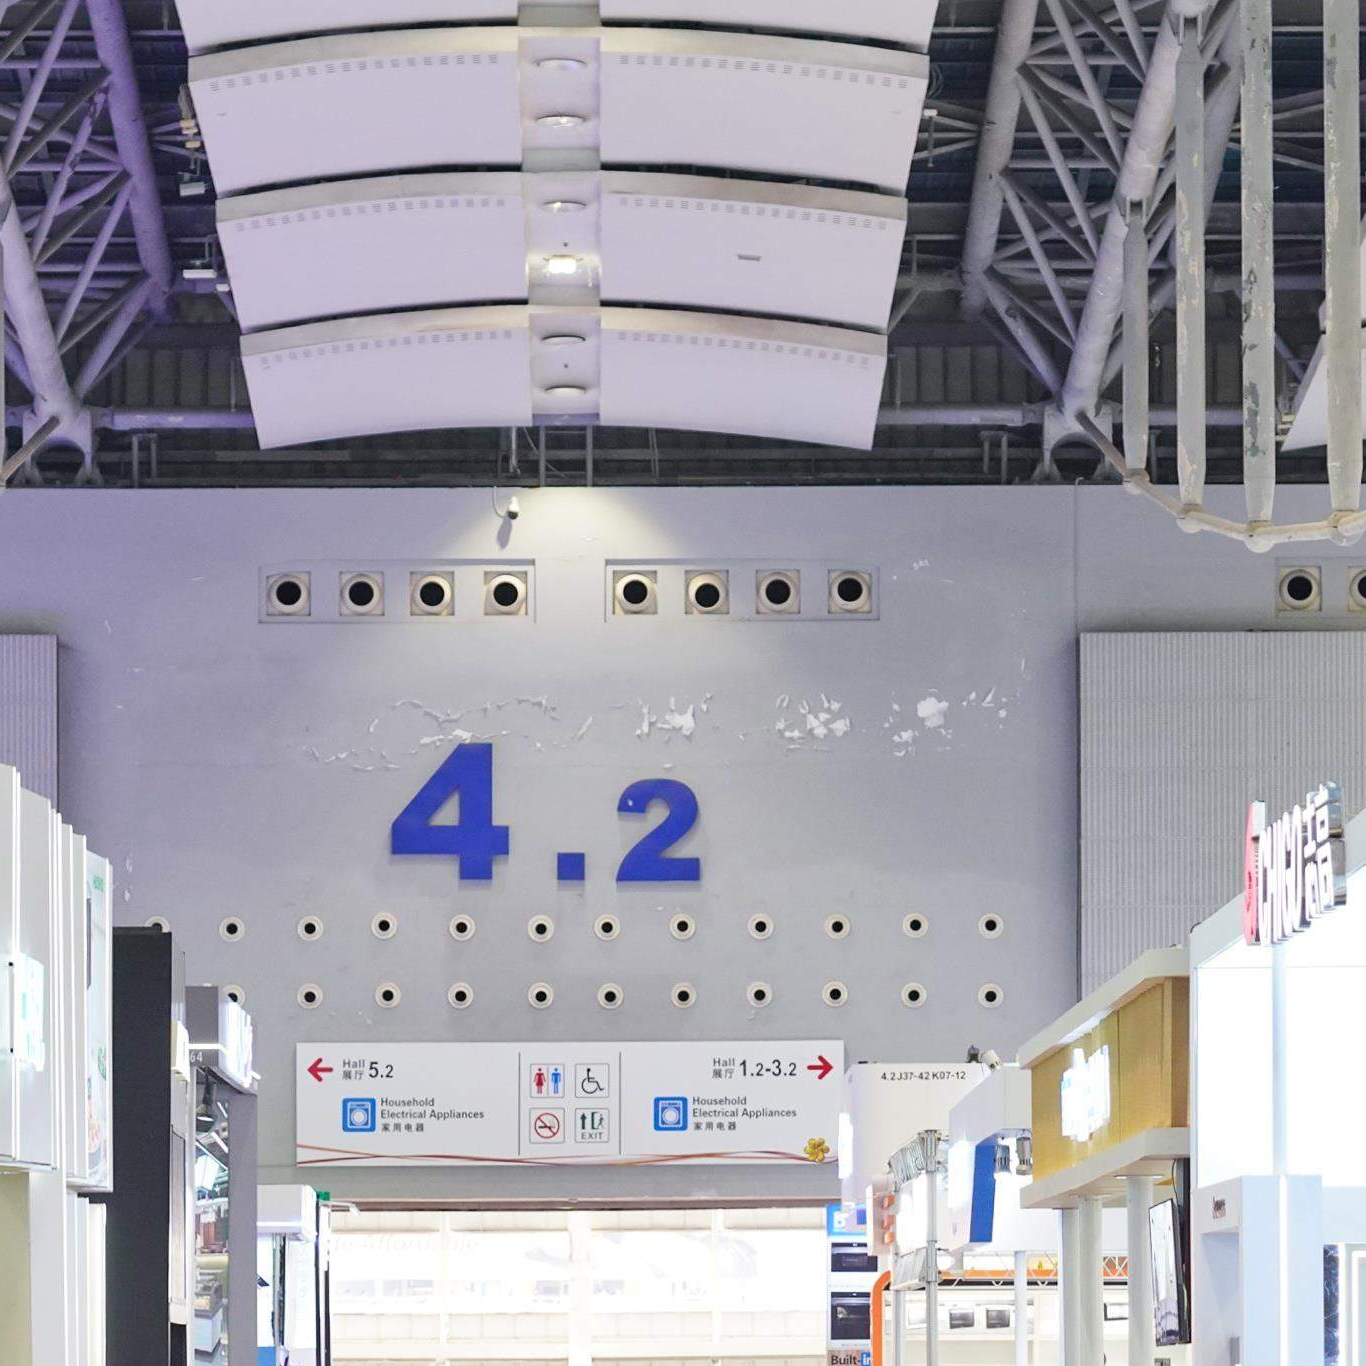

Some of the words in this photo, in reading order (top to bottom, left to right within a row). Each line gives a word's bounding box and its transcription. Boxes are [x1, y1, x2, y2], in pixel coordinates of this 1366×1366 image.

[391, 742, 701, 882] 4.2
[342, 1059, 365, 1068] Hall
[712, 1057, 735, 1067] Hall
[368, 1061, 394, 1078] 5.2
[739, 1059, 797, 1077] 1.2-3.2
[342, 1070, 365, 1080] 展厅
[712, 1068, 735, 1079] 展厅
[380, 1098, 434, 1107] Household
[692, 1096, 747, 1106] Household
[380, 1109, 426, 1119] Electrical
[429, 1109, 484, 1121] Appliances
[692, 1108, 740, 1118] Electrical
[742, 1108, 797, 1119] Appliances
[381, 1123, 424, 1132] 家用电器
[693, 1121, 736, 1131] 家用电器
[581, 1131, 603, 1140] EXIT
